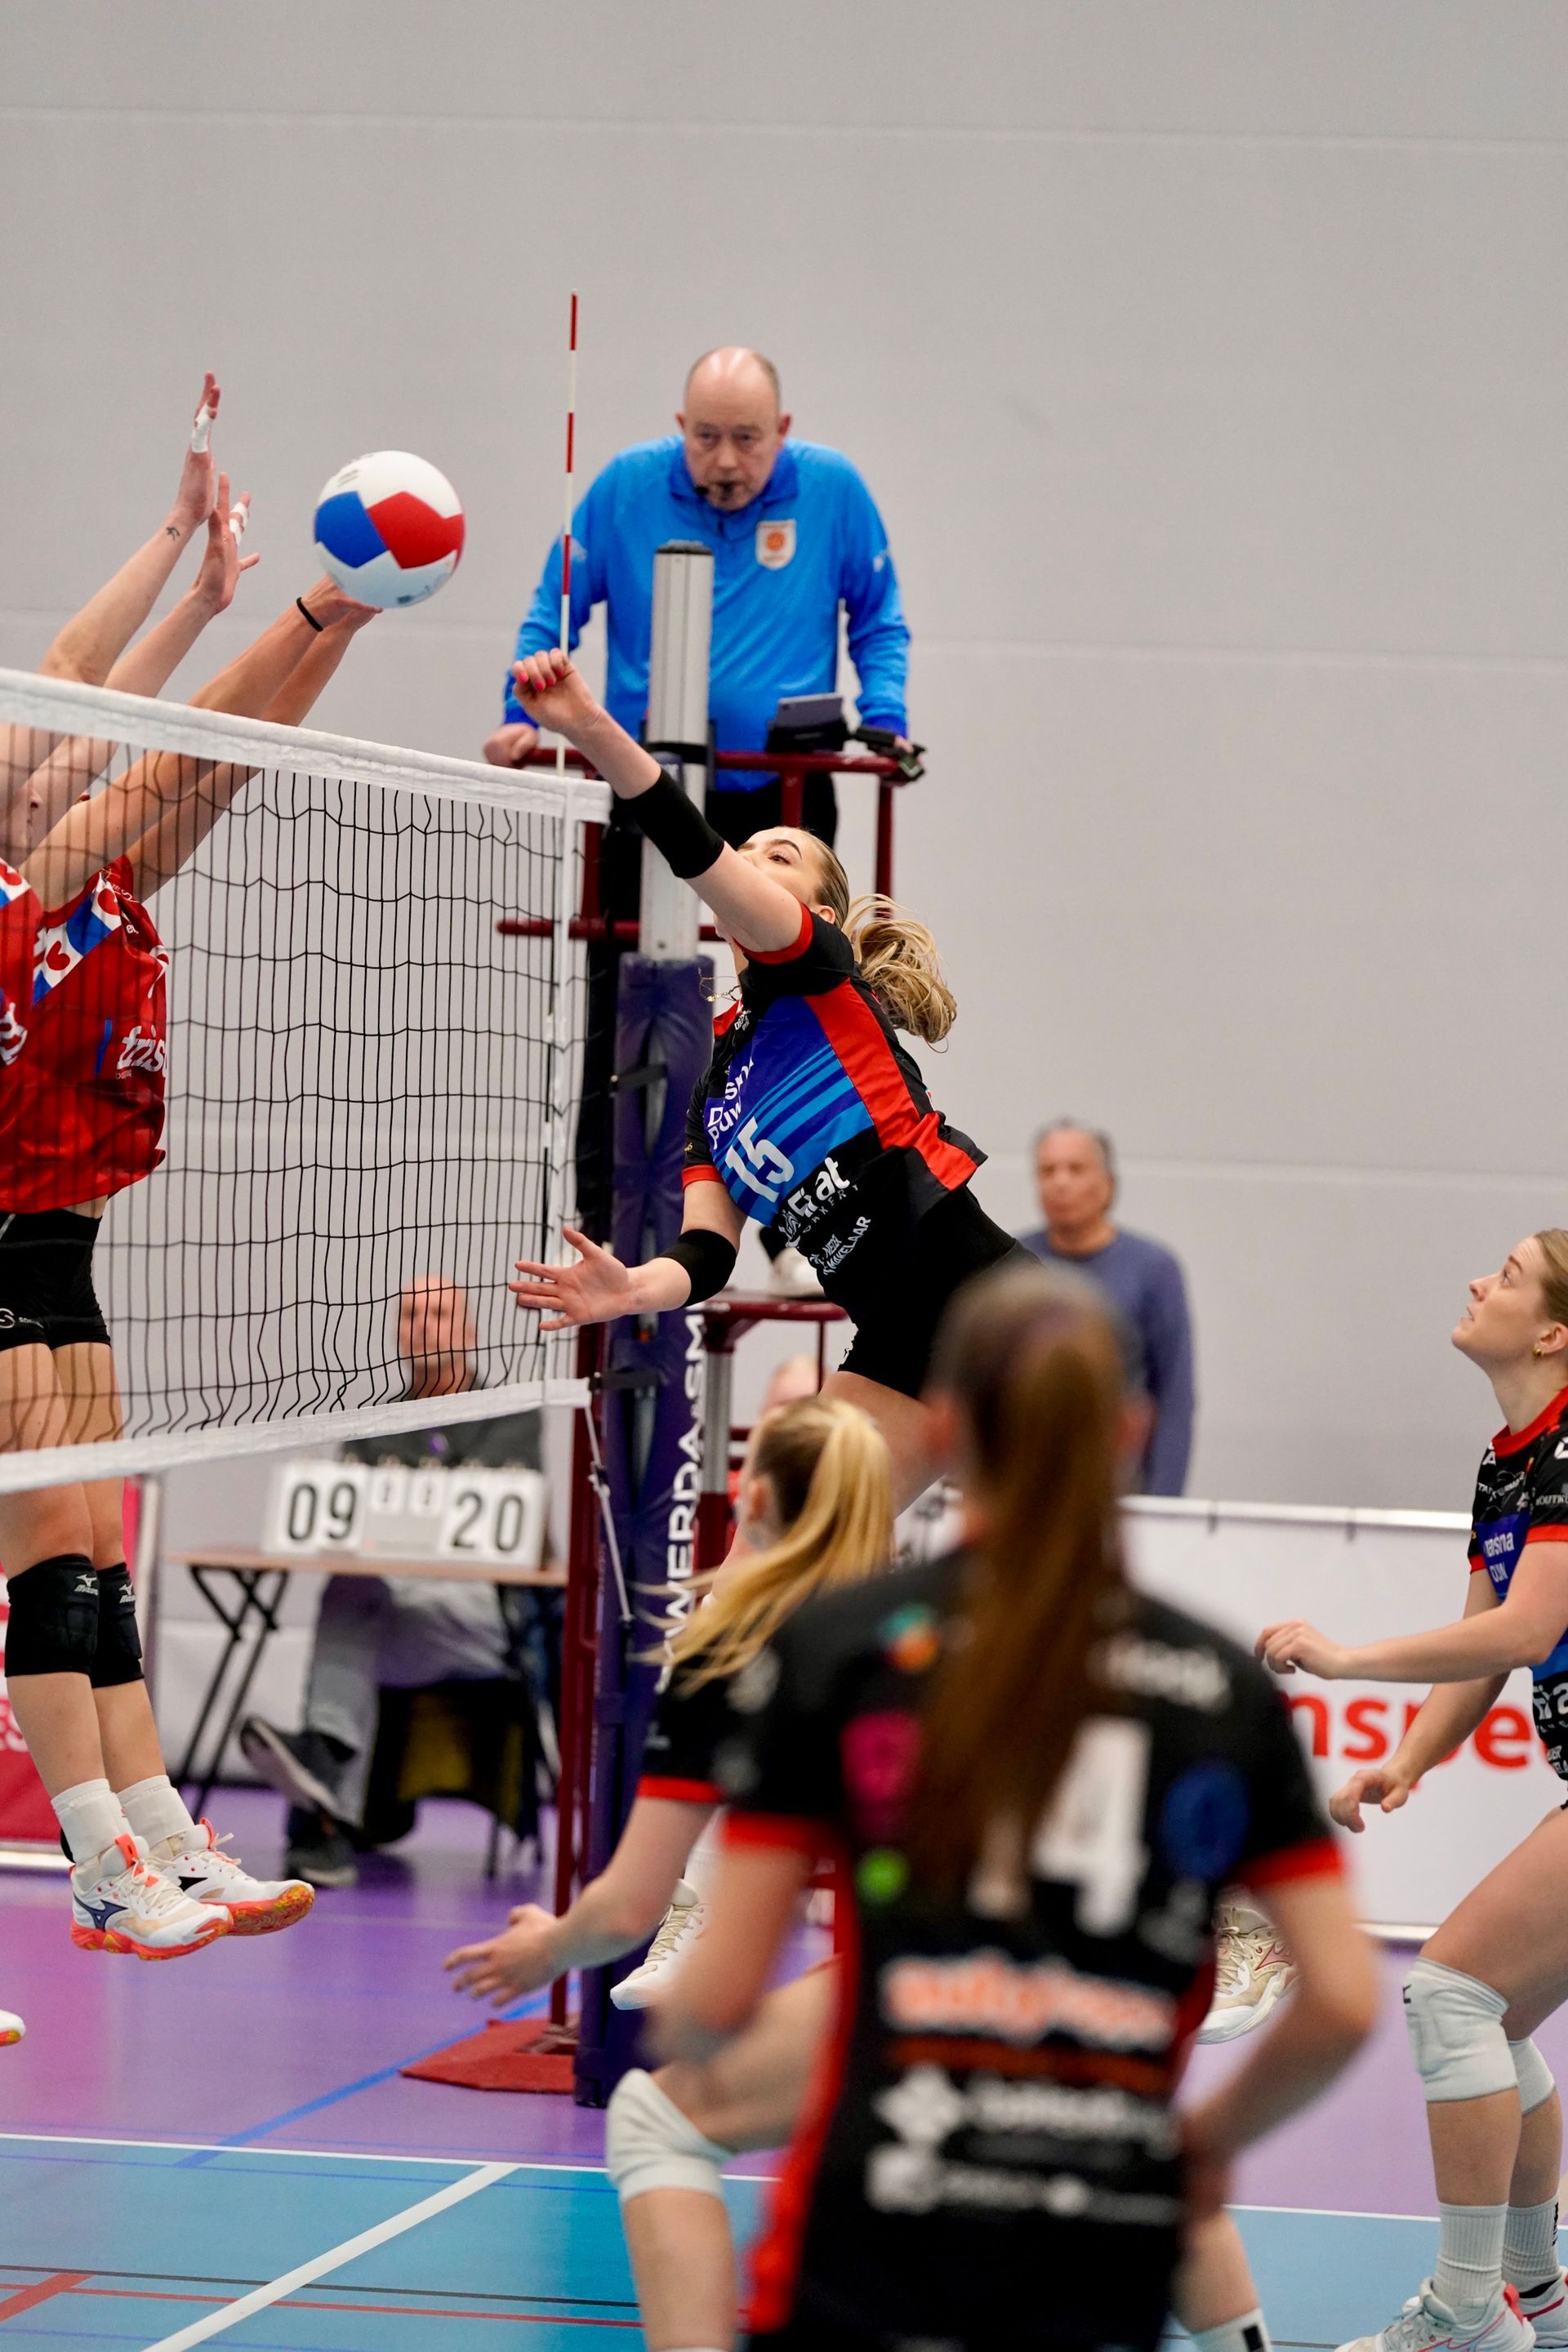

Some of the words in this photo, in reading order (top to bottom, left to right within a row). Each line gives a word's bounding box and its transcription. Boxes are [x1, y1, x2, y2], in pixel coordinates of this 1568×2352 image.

[724, 1116, 795, 1204] 15
[287, 1481, 358, 1543] 09
[452, 1490, 526, 1552] 20
[655, 1418, 702, 1693] WERDA
[1282, 1690, 1548, 1790] nse
